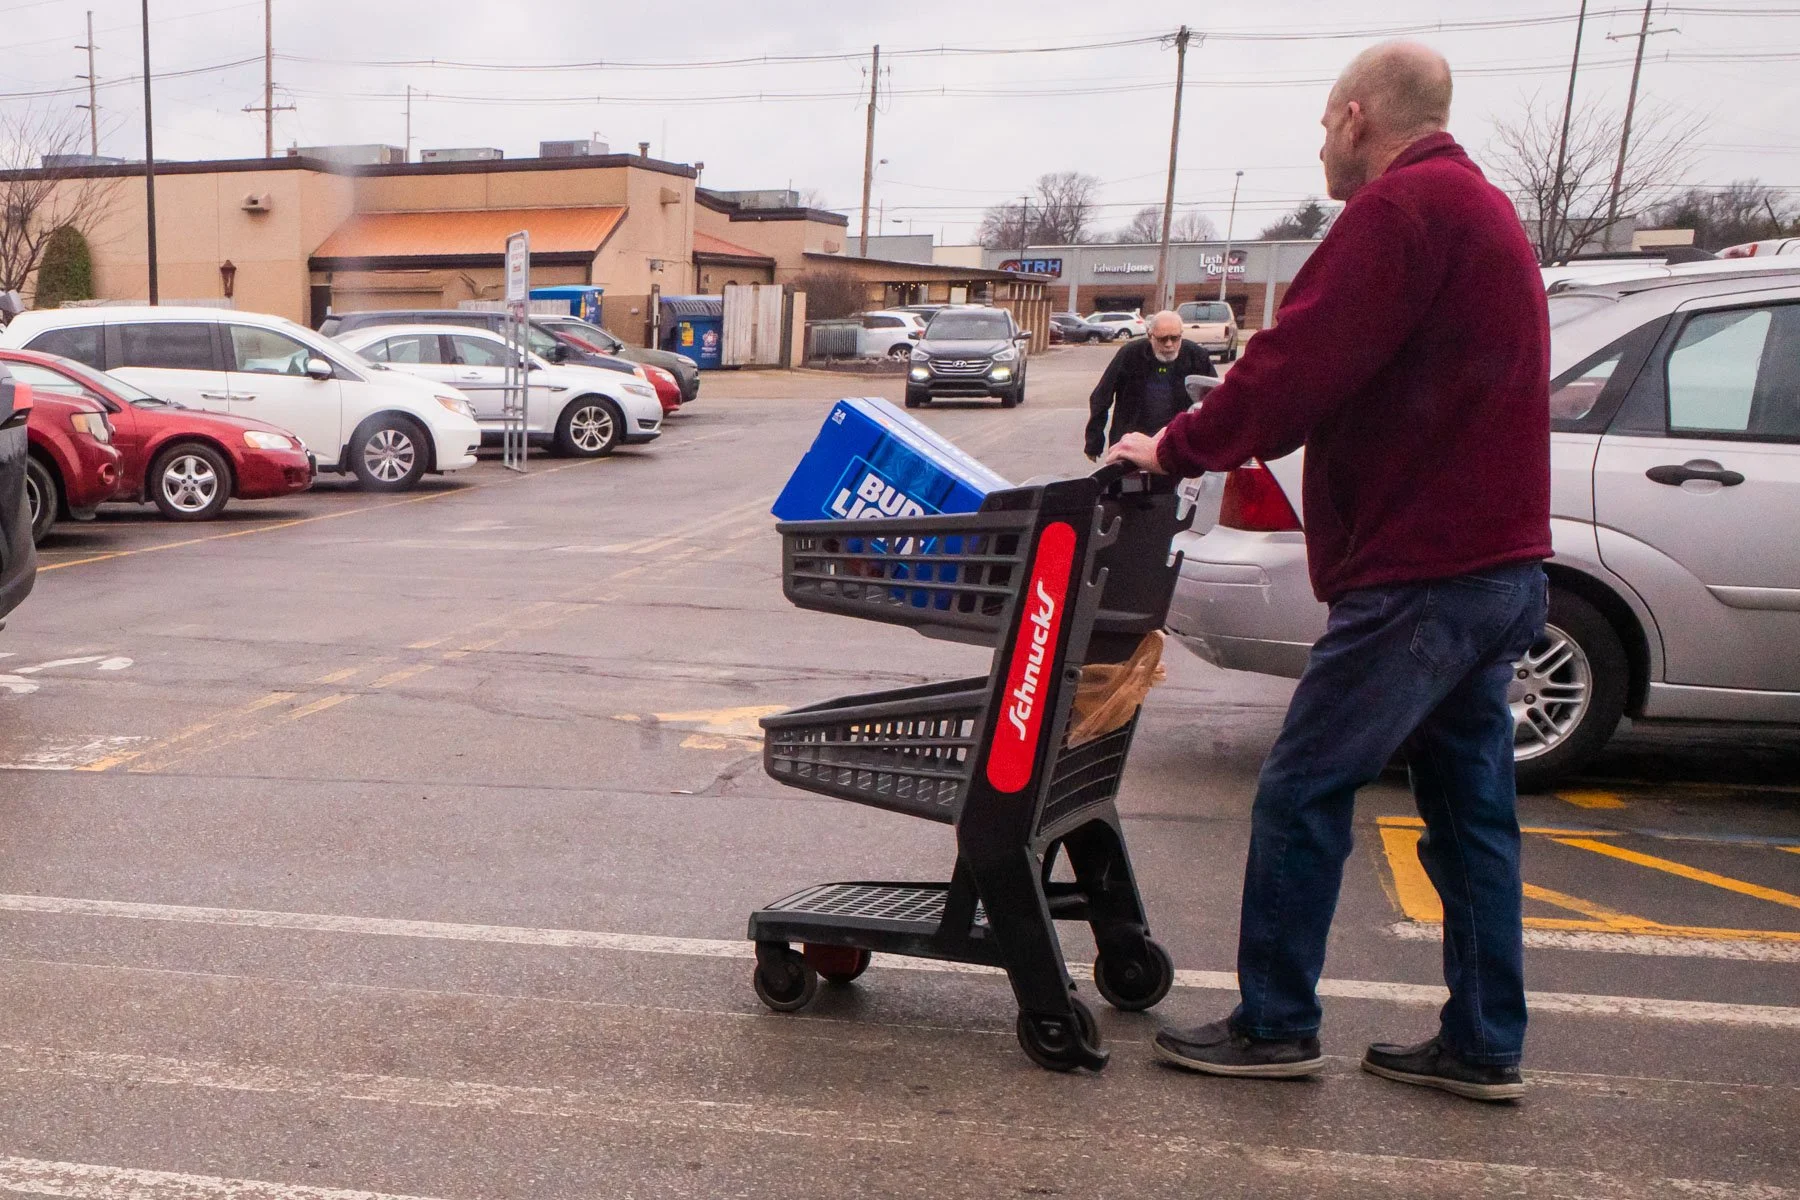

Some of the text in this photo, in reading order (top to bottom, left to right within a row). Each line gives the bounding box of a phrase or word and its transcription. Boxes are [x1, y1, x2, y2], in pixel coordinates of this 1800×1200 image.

[1022, 260, 1060, 273] TRH
[1200, 253, 1222, 267] Lash
[1093, 262, 1154, 273] Edward Jones
[833, 408, 847, 420] 24
[1008, 579, 1056, 741] Schnucks
